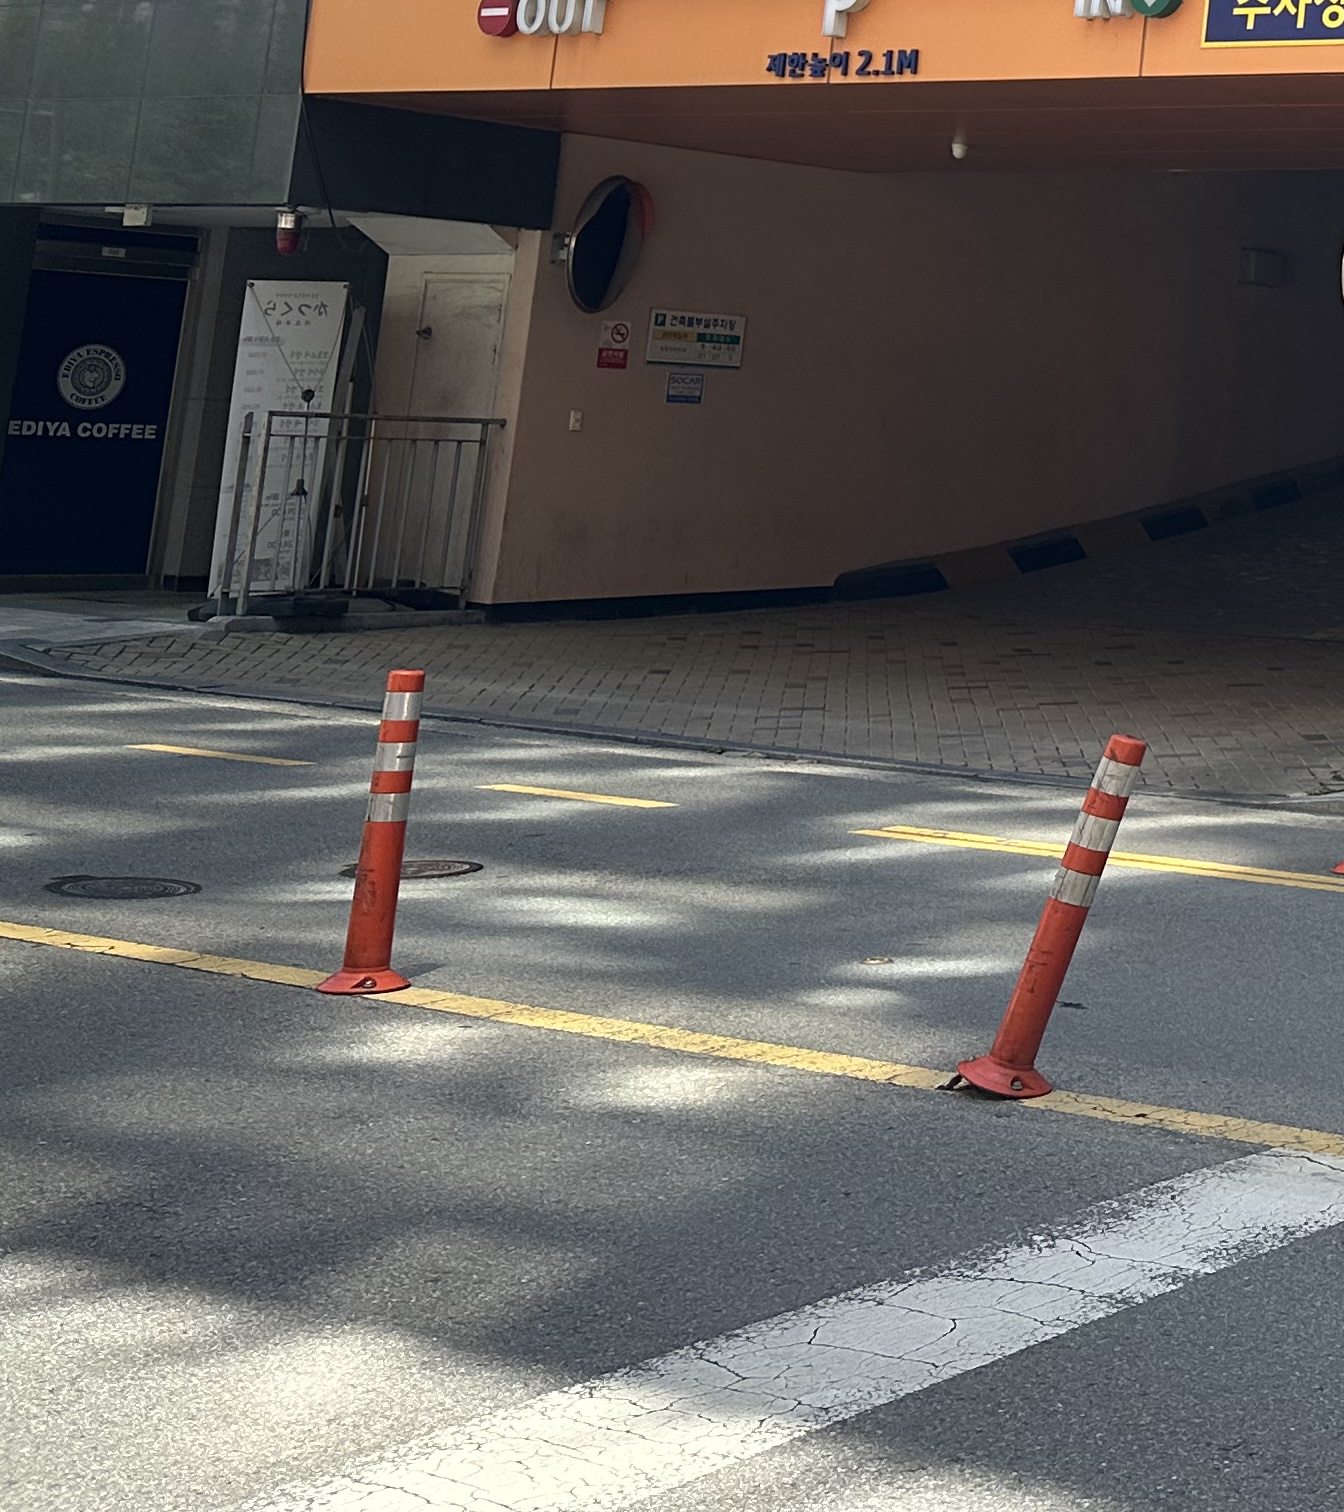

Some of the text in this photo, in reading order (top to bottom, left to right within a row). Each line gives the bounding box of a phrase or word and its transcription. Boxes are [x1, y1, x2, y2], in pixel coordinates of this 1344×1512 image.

[766, 48, 920, 78] 제한높이 2.1M
[7, 420, 158, 440] EDIYA COFFEE
